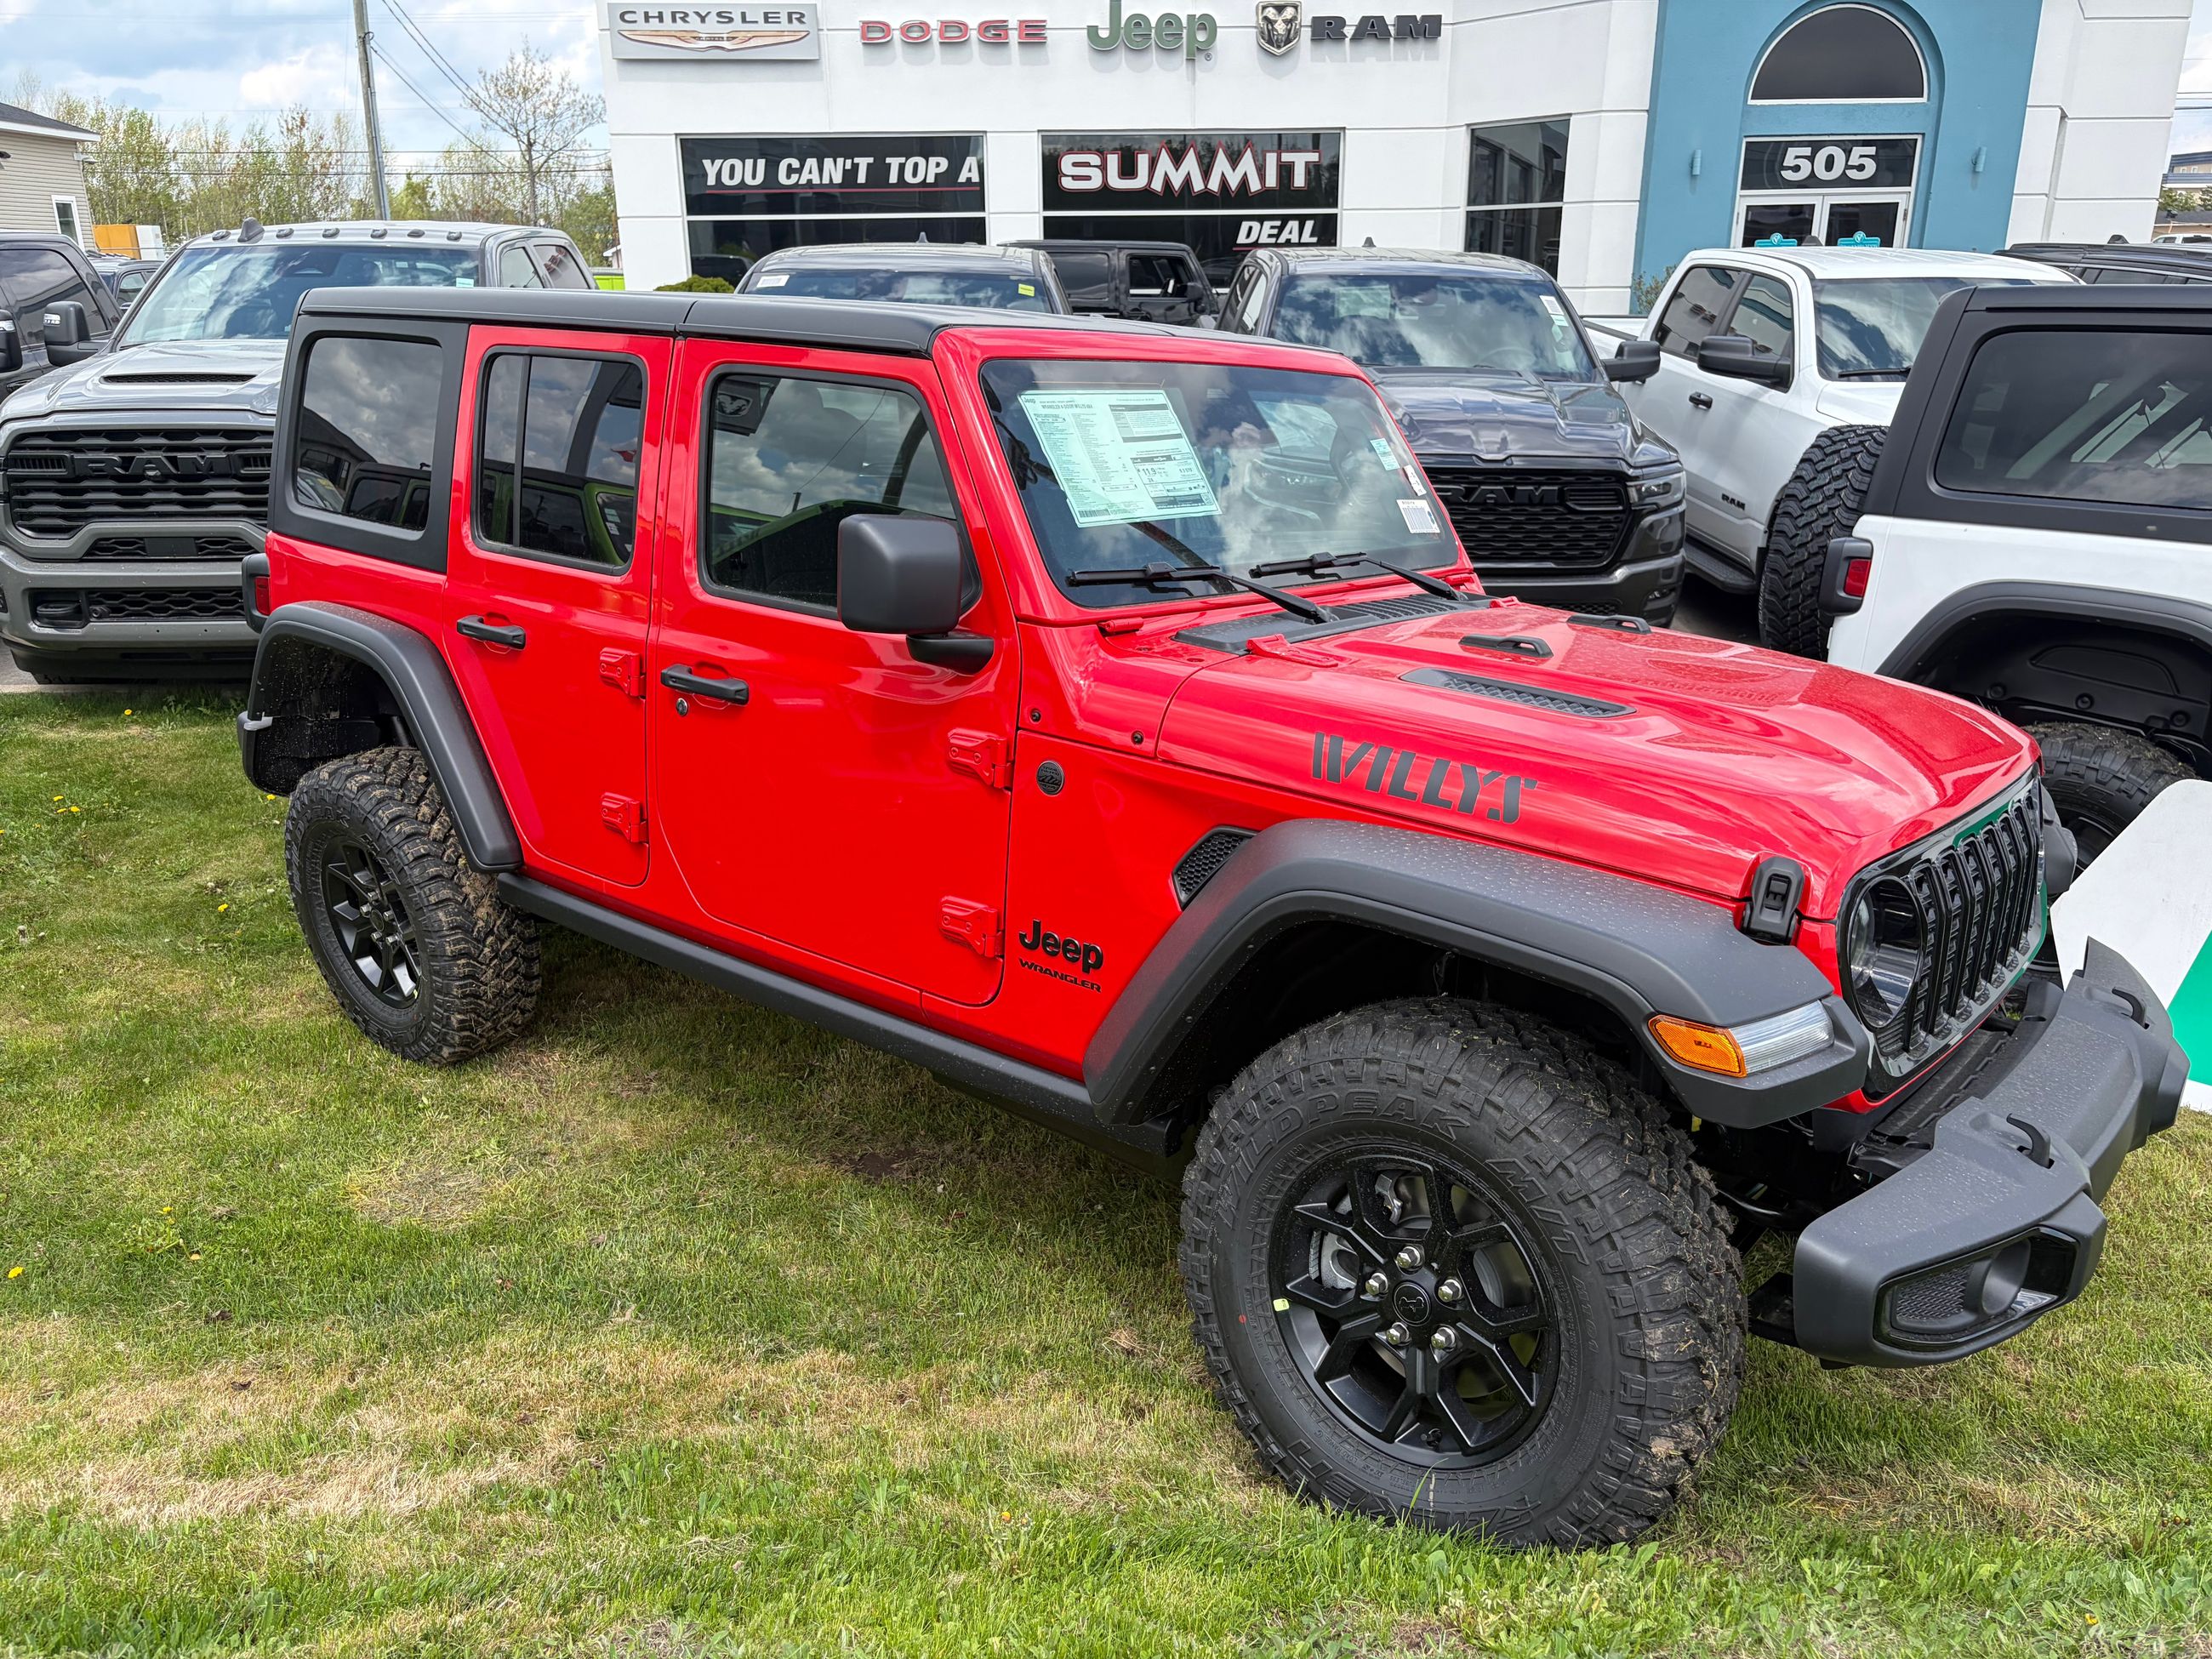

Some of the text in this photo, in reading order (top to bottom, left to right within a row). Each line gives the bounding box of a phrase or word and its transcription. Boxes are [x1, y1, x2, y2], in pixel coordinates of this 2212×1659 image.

[619, 10, 807, 25] CHRYSLER
[858, 19, 1047, 44] DODGE
[1086, 0, 1218, 60] Jeep
[1311, 14, 1443, 40] RAM
[702, 156, 980, 187] YOU CAN'T TOP A
[1058, 140, 1322, 197] SUMMIT
[1780, 145, 1877, 181] 505
[1237, 219, 1319, 245] DEAL
[73, 453, 231, 476] RAM
[1433, 485, 1559, 505] RAM
[1721, 493, 1746, 511] RAM
[1312, 732, 1538, 824] WILLYS
[1018, 919, 1104, 973] Jeep
[1018, 957, 1102, 993] WRANGLER
[1216, 1088, 1471, 1230] WILDPEAK
